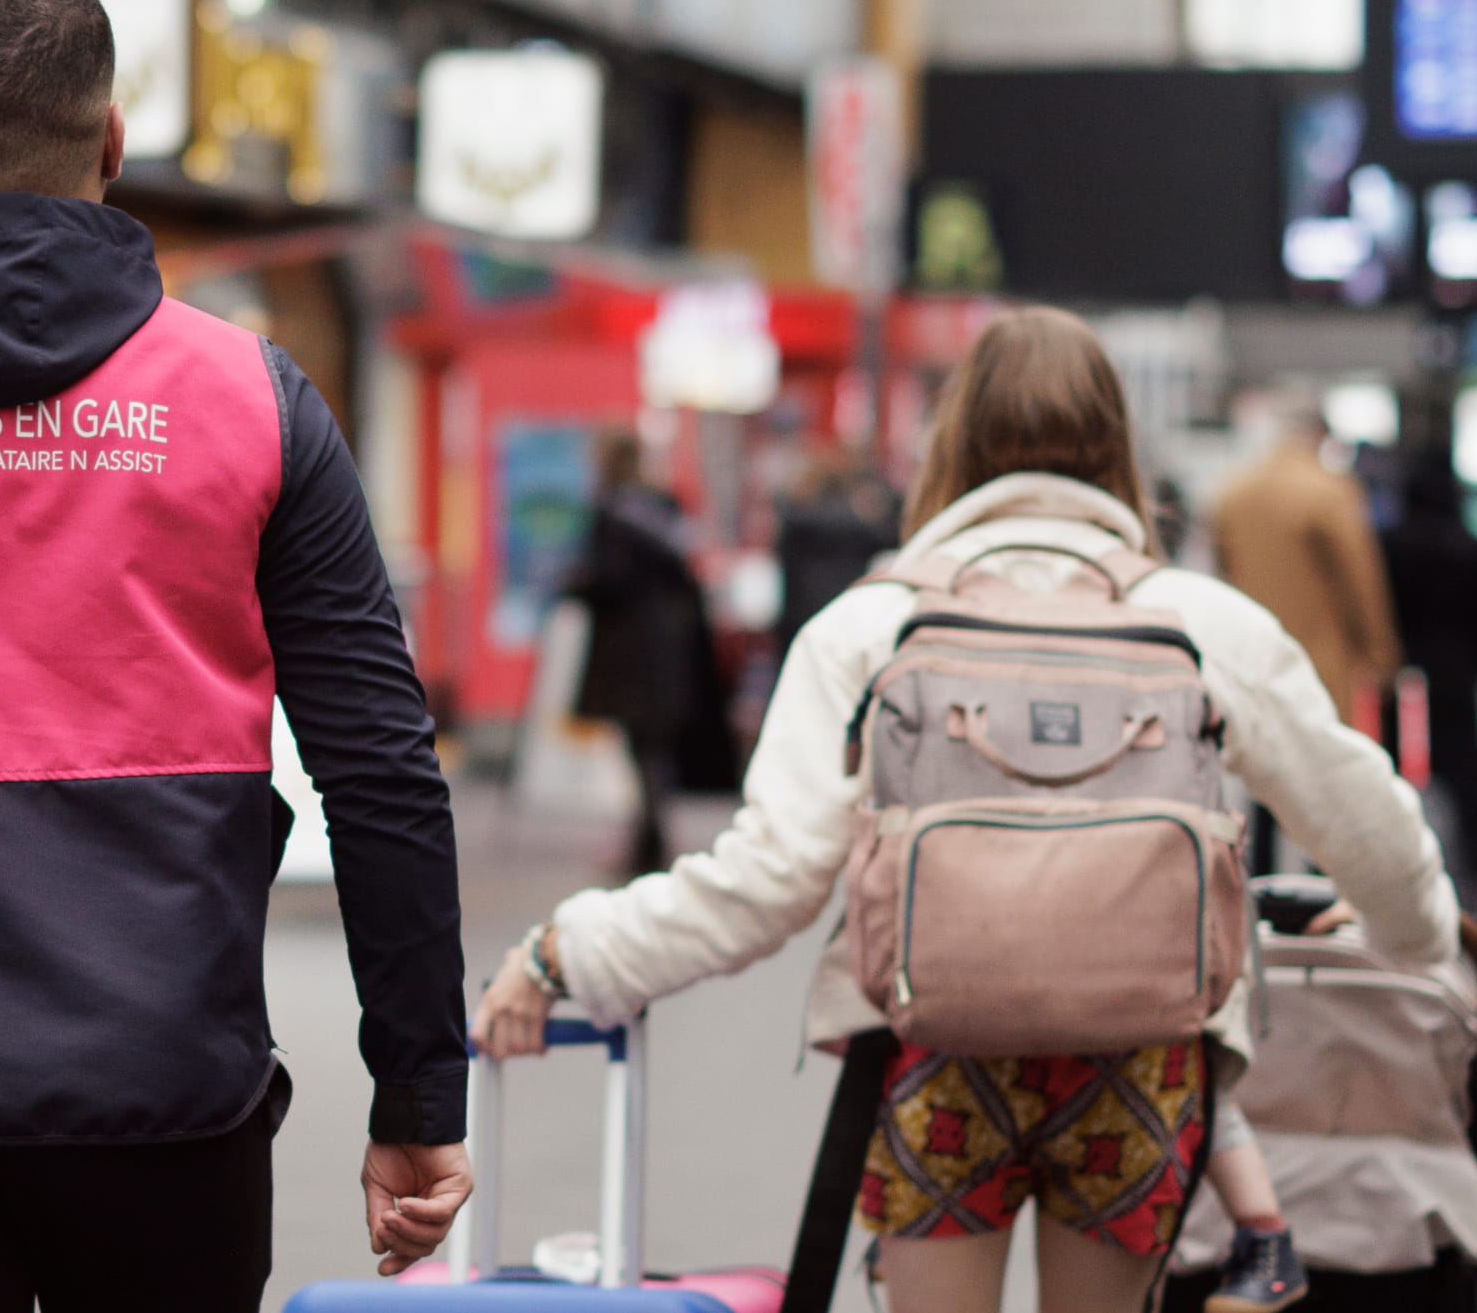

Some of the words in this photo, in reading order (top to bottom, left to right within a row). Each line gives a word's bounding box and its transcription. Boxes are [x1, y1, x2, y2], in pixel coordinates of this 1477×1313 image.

[15, 400, 61, 438] EN
[73, 399, 169, 443] GARE
[70, 450, 87, 471] N
[94, 450, 167, 475] ASSIST
